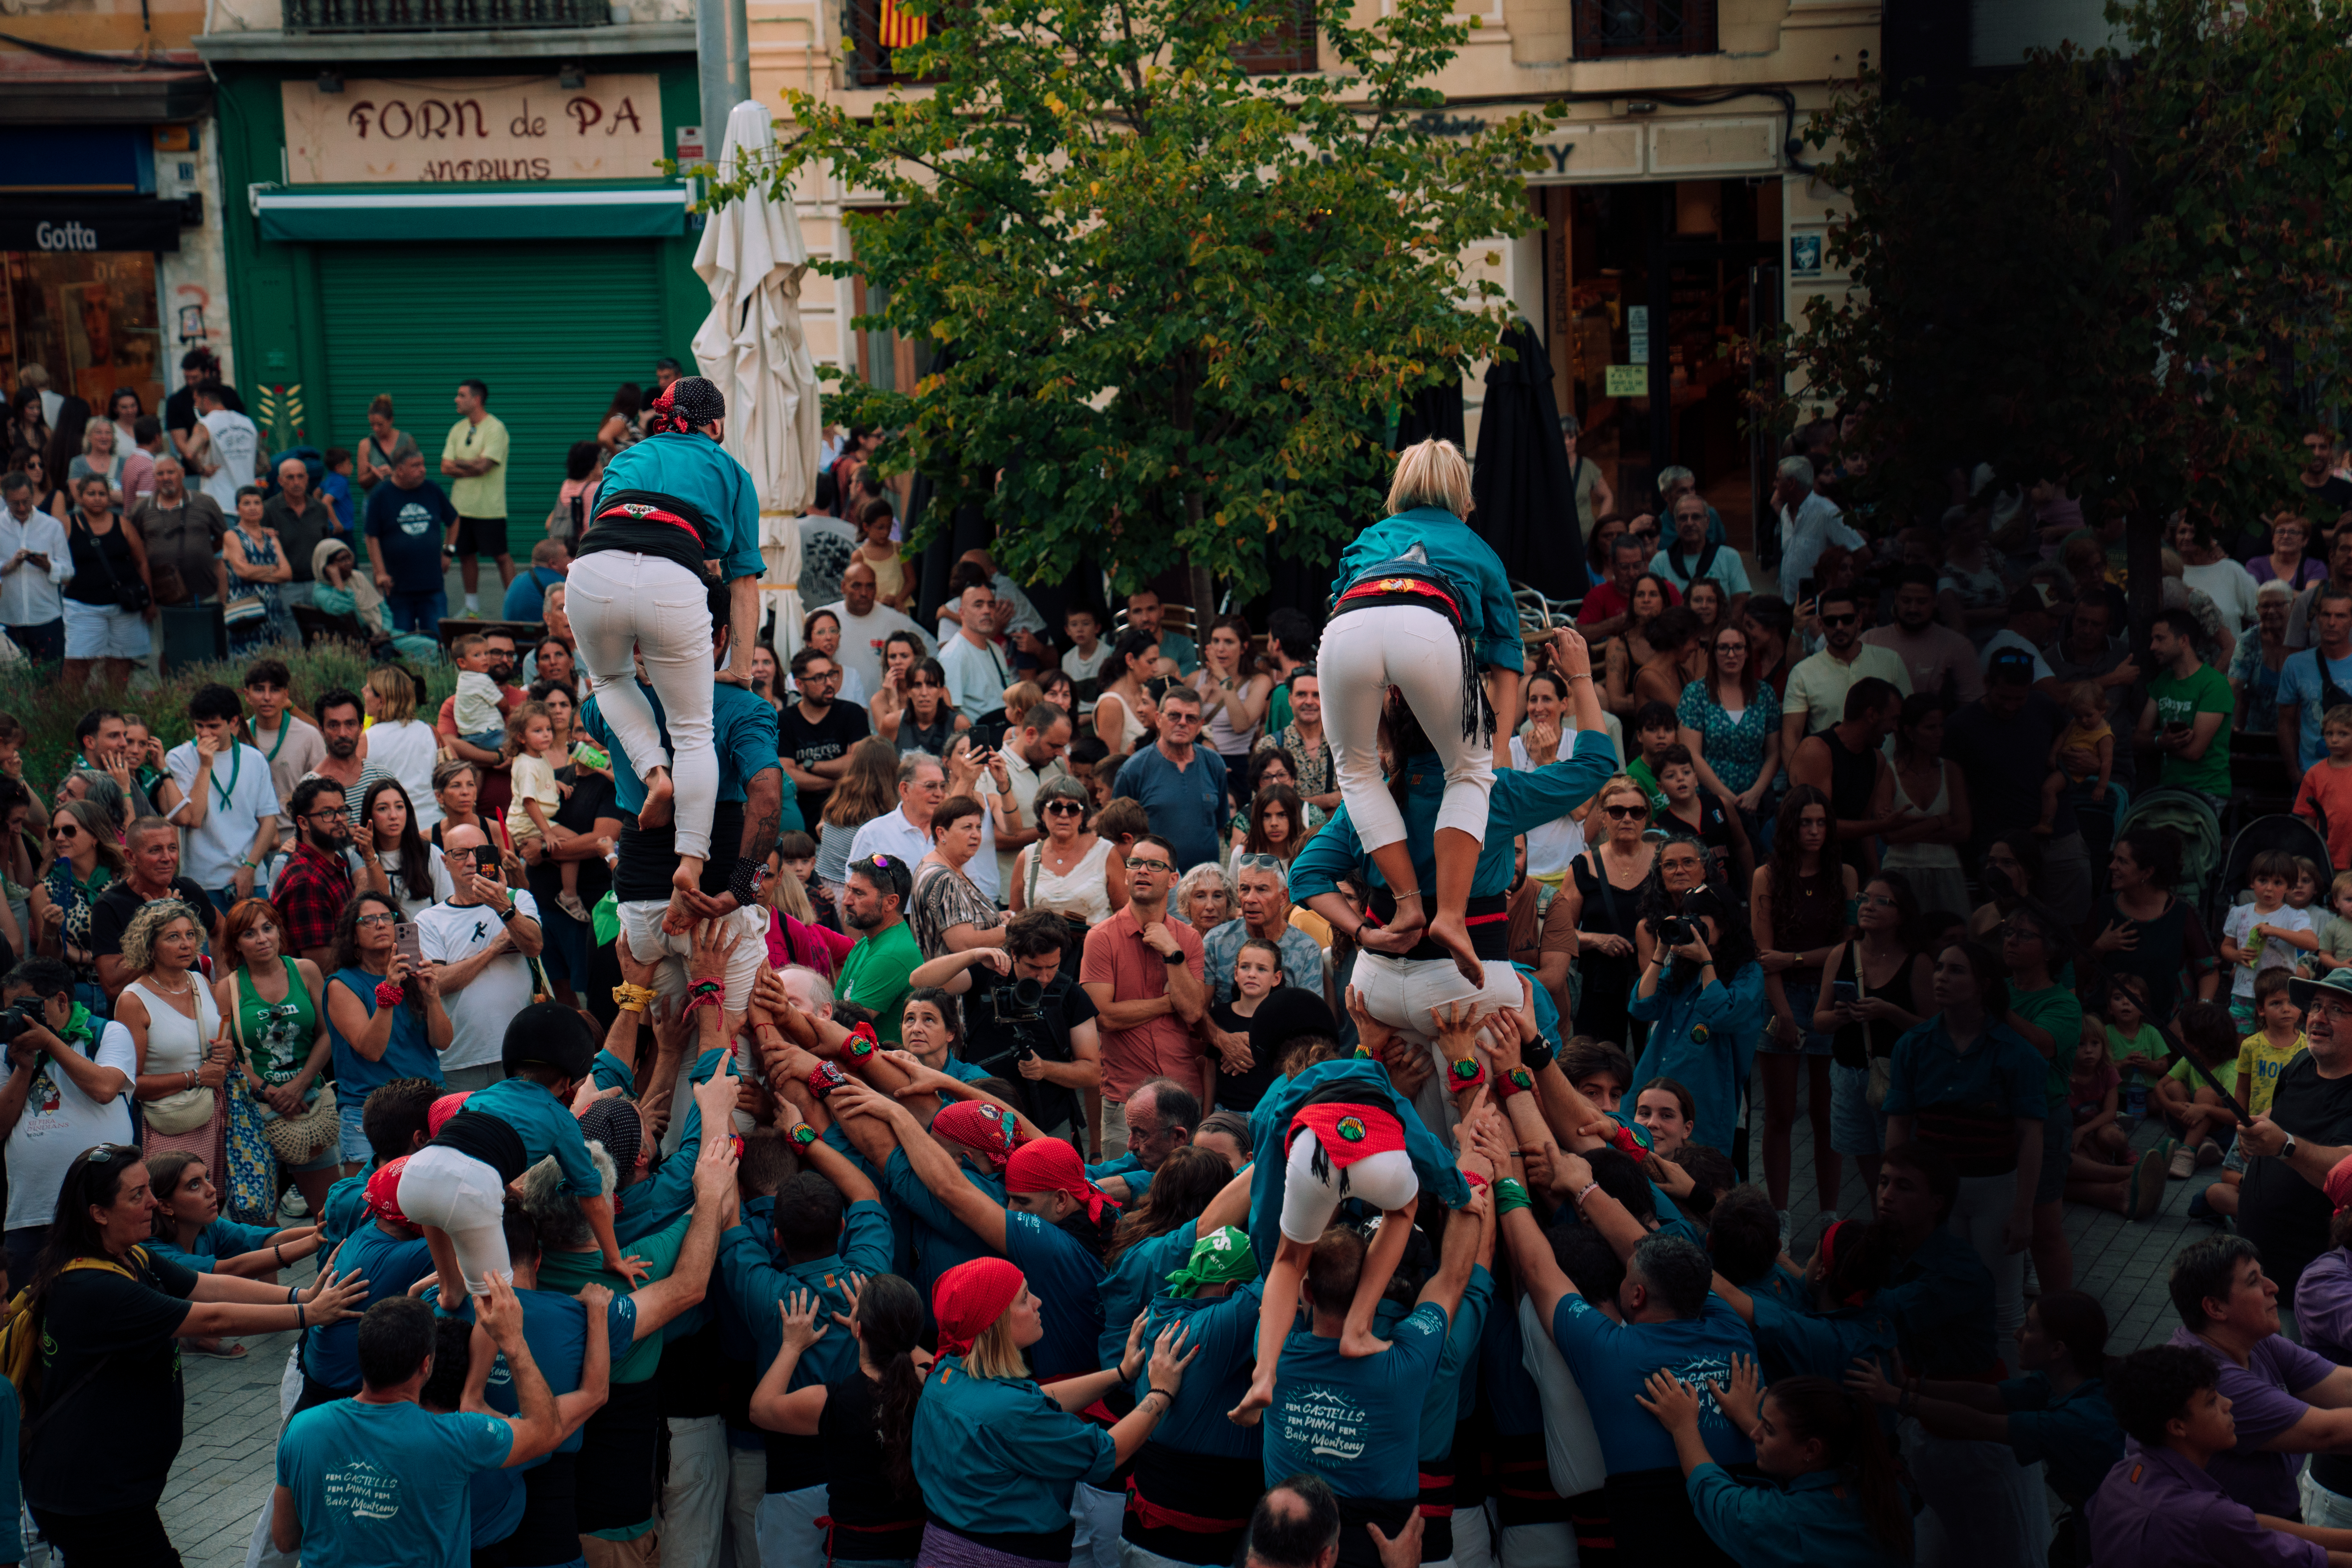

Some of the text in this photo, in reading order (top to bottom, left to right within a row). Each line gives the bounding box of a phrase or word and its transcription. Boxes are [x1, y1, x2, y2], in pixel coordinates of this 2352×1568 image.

[510, 98, 547, 136] de
[566, 96, 640, 135] PA
[36, 221, 97, 250] Gotta
[257, 1005, 299, 1020] Sm
[1688, 1369, 1732, 1382] CASTEL
[1286, 1403, 1365, 1422] FEM CASTELLS
[1288, 1416, 1356, 1435] FEM PINYA FEM
[1285, 1426, 1365, 1452] Baix Montseny
[344, 1473, 397, 1489] CASTELLS
[345, 1483, 371, 1497] PINYA
[325, 1495, 398, 1513] Baix Montseny
